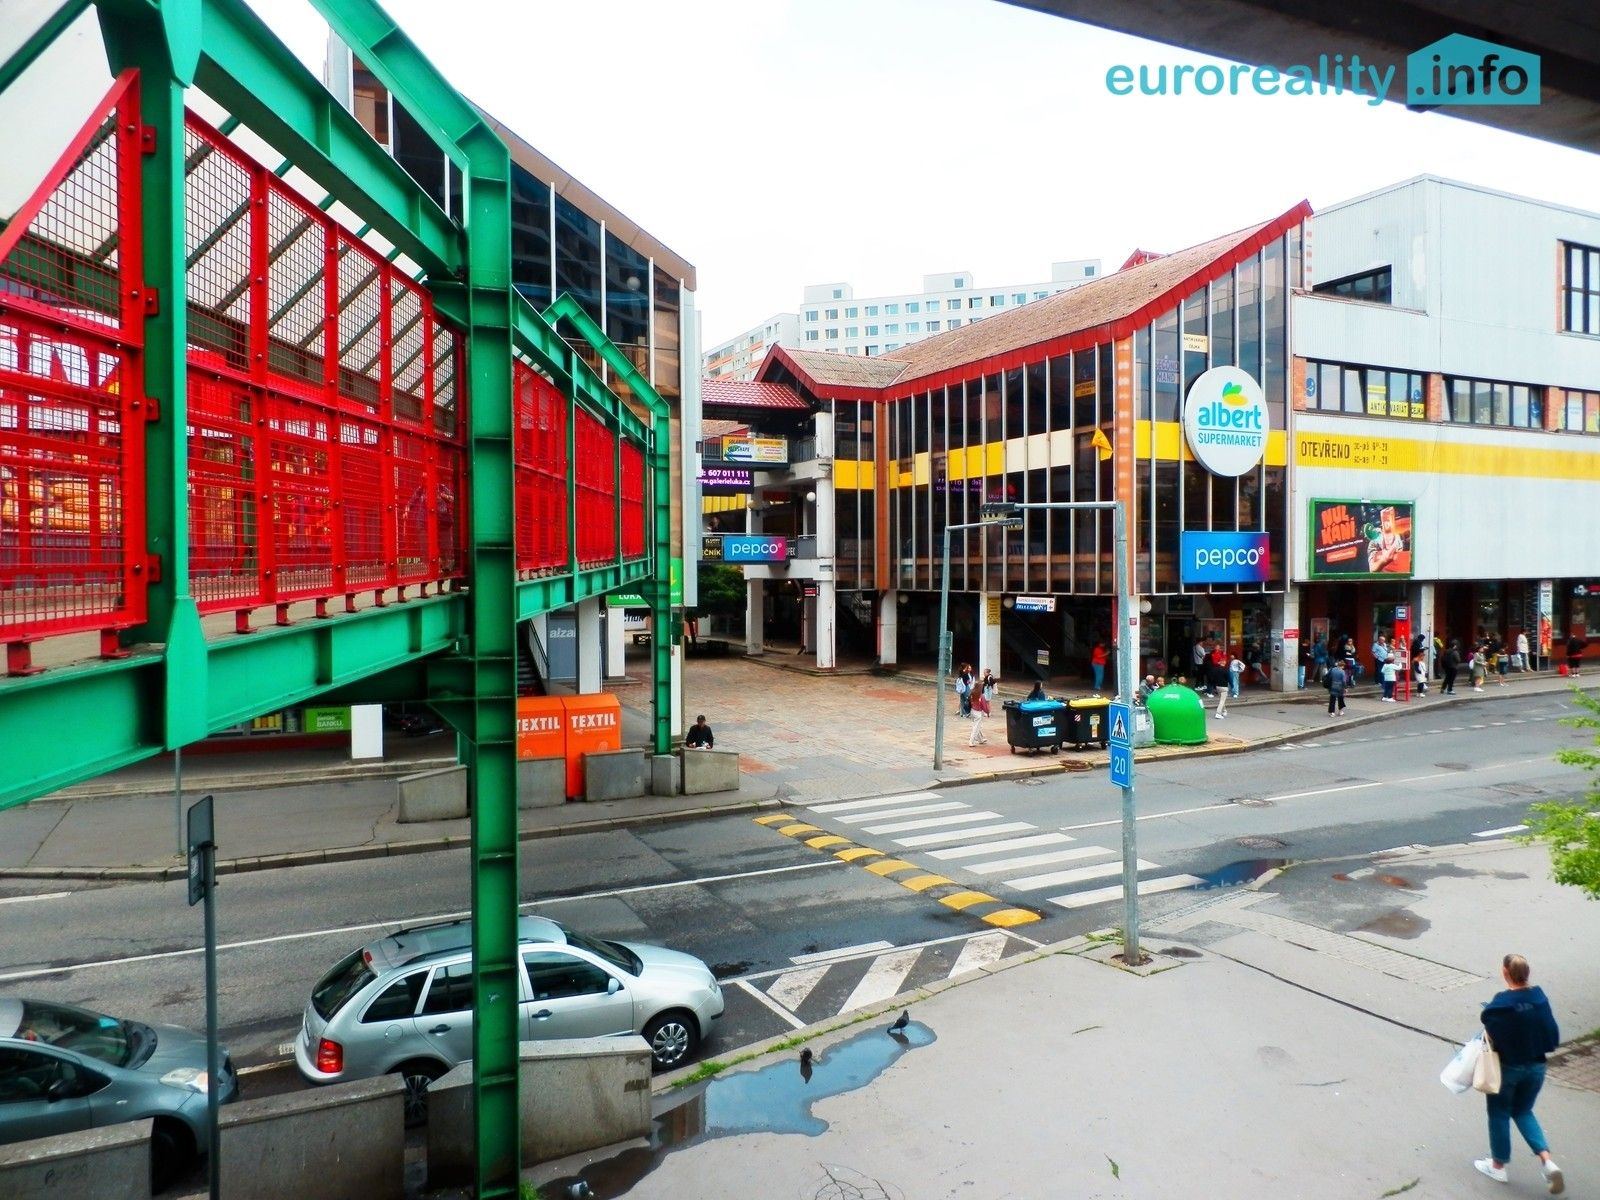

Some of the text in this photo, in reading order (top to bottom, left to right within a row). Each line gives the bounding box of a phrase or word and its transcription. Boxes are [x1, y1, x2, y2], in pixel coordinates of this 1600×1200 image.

[1198, 401, 1262, 430] albert
[1198, 432, 1262, 448] SUPERMARKET
[1301, 439, 1350, 459] OTEVŘENO
[708, 469, 722, 477] 607
[722, 470, 735, 478] 011
[736, 470, 749, 478] 111
[571, 712, 617, 729] TEXTIL
[1114, 755, 1126, 775] 20
